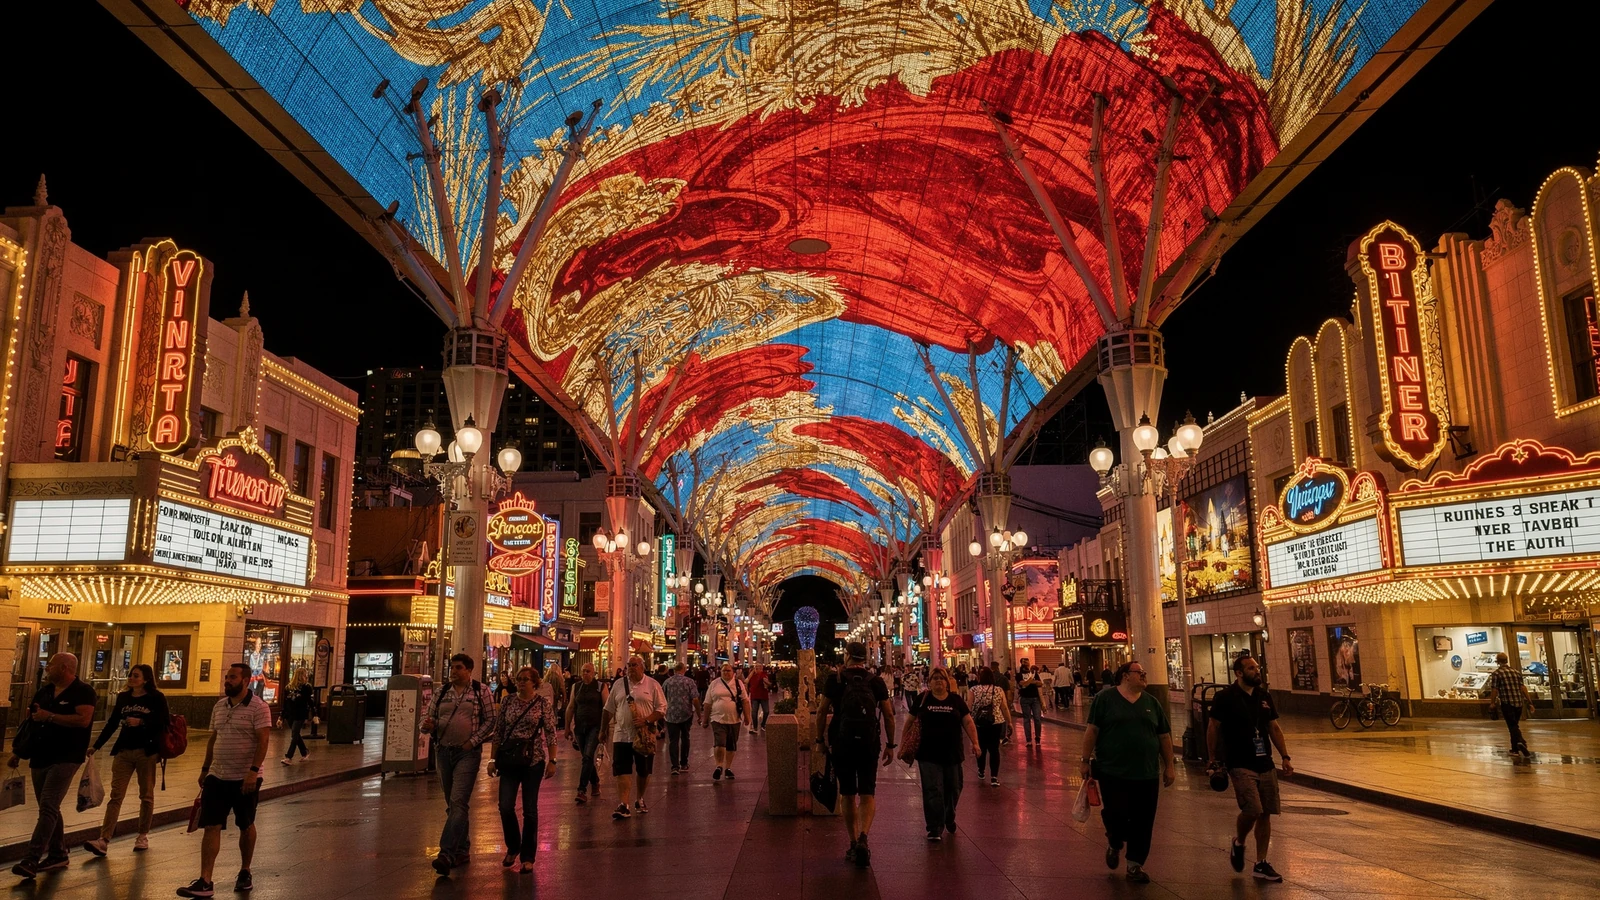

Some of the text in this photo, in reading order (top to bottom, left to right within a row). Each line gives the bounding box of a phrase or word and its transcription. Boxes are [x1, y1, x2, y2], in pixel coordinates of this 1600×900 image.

[156, 260, 195, 443] VINRTA
[1380, 243, 1429, 441] BITINER
[1485, 536, 1566, 553] THE AUTH
